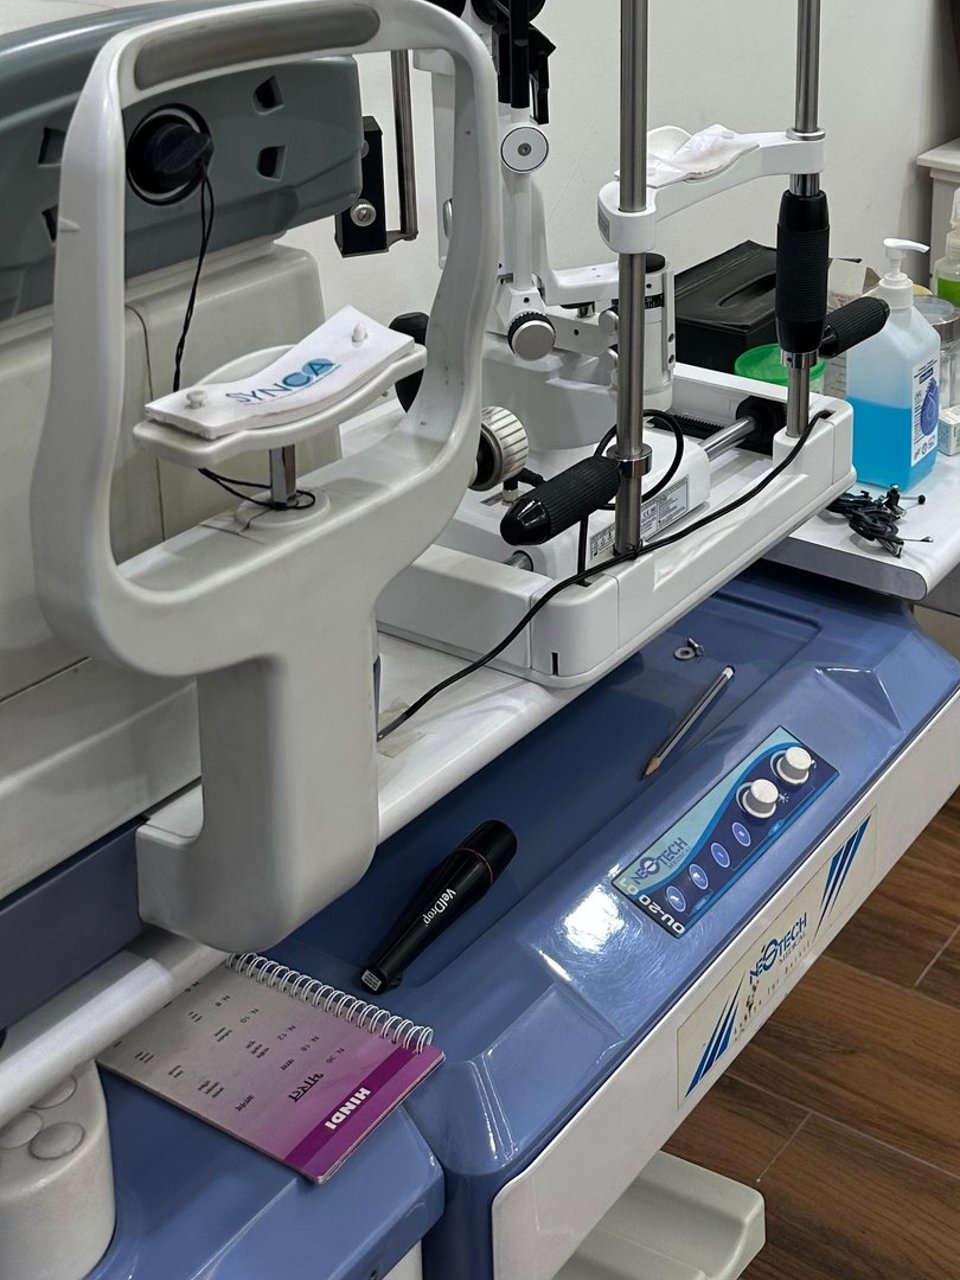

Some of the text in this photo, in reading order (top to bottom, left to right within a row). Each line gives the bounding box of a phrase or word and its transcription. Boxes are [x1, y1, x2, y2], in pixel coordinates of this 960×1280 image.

[225, 358, 334, 404] SYNCA
[288, 1072, 324, 1103] भारत
[324, 1087, 372, 1131] HINDI
